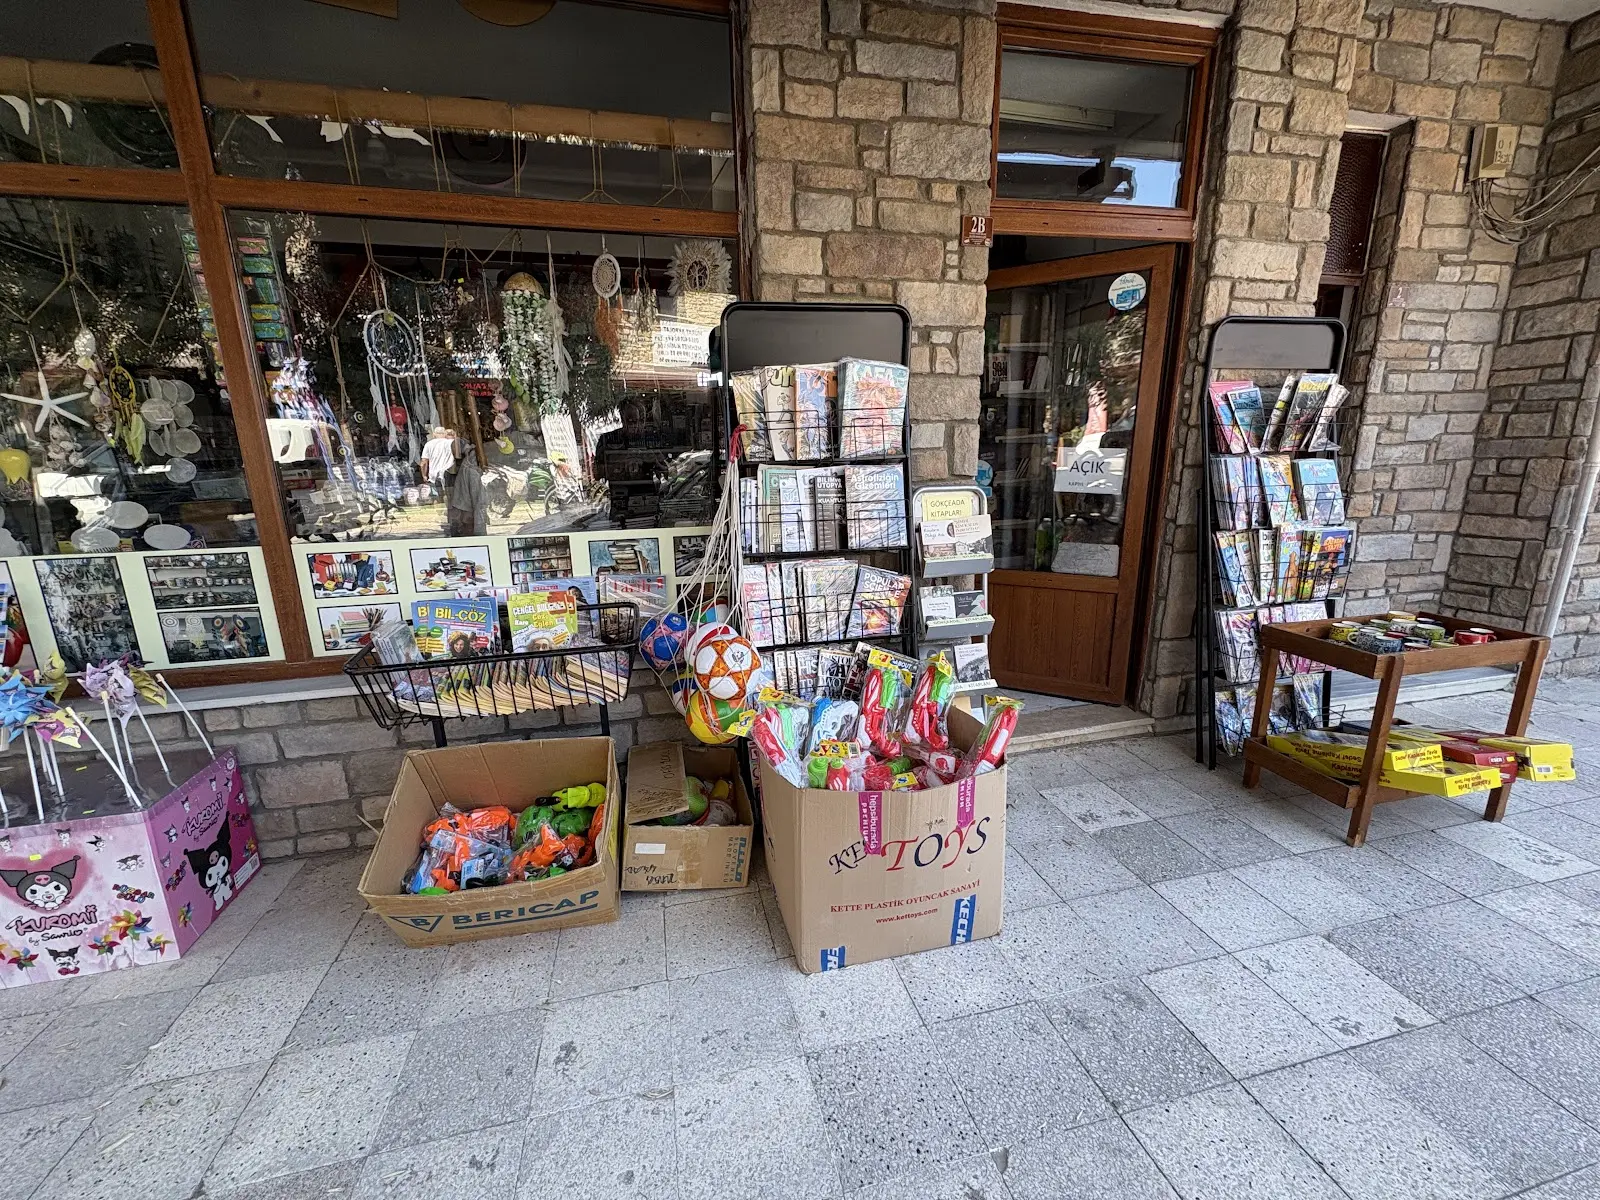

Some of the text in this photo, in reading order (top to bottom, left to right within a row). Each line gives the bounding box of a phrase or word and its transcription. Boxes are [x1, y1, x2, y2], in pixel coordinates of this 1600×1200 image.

[971, 216, 986, 233] 2B
[1069, 460, 1105, 476] AÇIK
[930, 499, 965, 508] GÖKÇEADA
[930, 509, 962, 518] KİTAPLARI
[864, 572, 905, 590] POPULAR
[435, 605, 487, 623] BİL-ÇÖZ
[965, 778, 974, 813] iburada
[868, 794, 878, 849] hepsiburada
[828, 816, 991, 875] KE TOYS
[864, 899, 903, 911] PLASTİK
[905, 889, 950, 904] OYUNCAK
[950, 879, 981, 895] SANAYİ
[452, 890, 600, 925] BERICAP
[875, 907, 938, 924] www.kettoys.com
[41, 930, 83, 942] Sanrio
